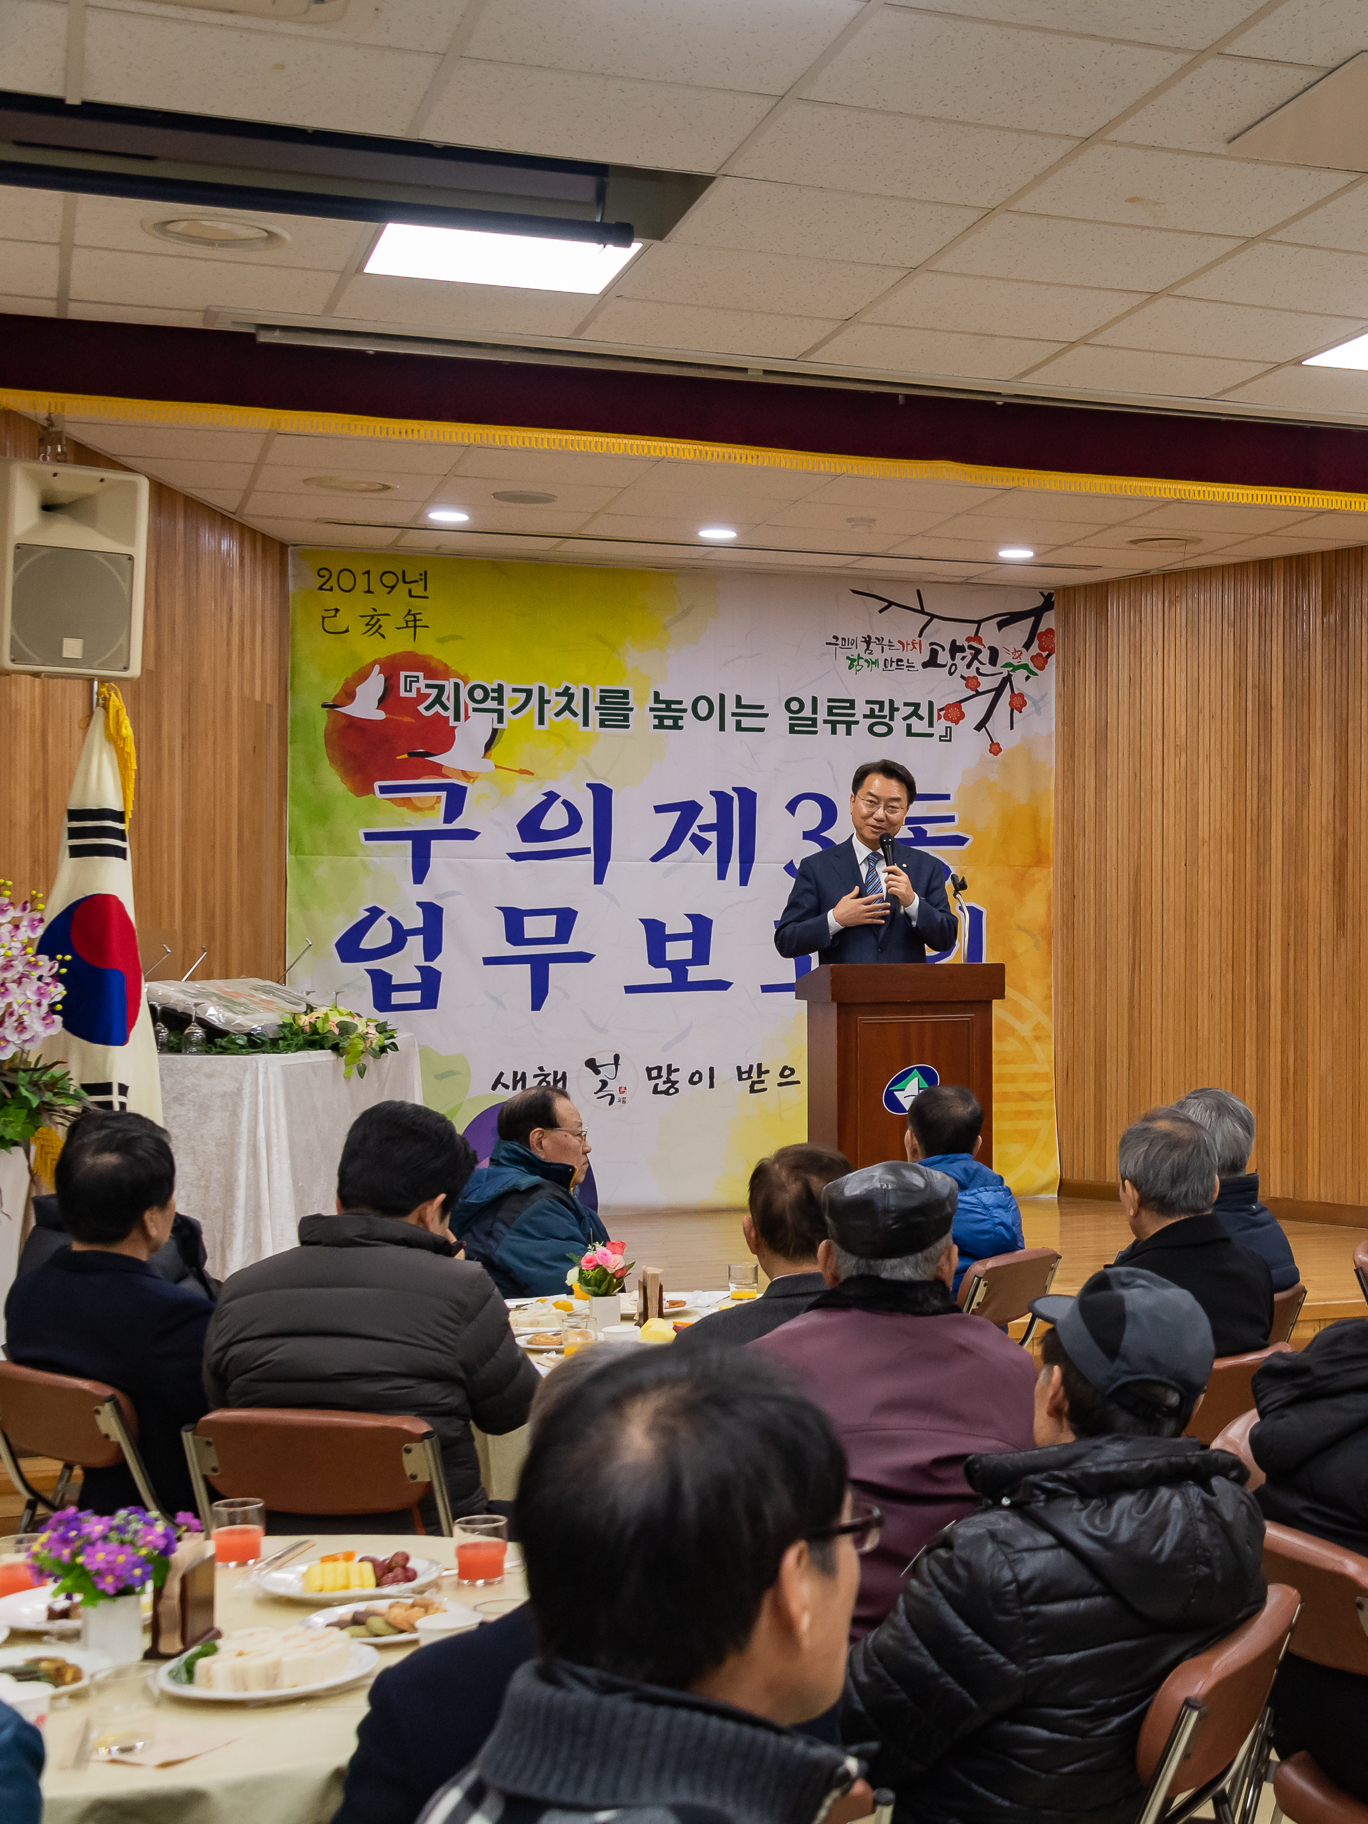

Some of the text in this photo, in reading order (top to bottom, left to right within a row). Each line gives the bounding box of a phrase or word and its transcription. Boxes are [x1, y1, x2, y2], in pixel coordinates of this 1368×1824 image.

[317, 566, 431, 600] 2019년
[320, 607, 431, 641] 己亥年
[846, 653, 880, 675] 함께
[921, 639, 1003, 676] 광진
[898, 639, 923, 655] 가치
[649, 690, 770, 736] 높이는
[584, 1053, 621, 1106] 복
[645, 1063, 715, 1096] 많이
